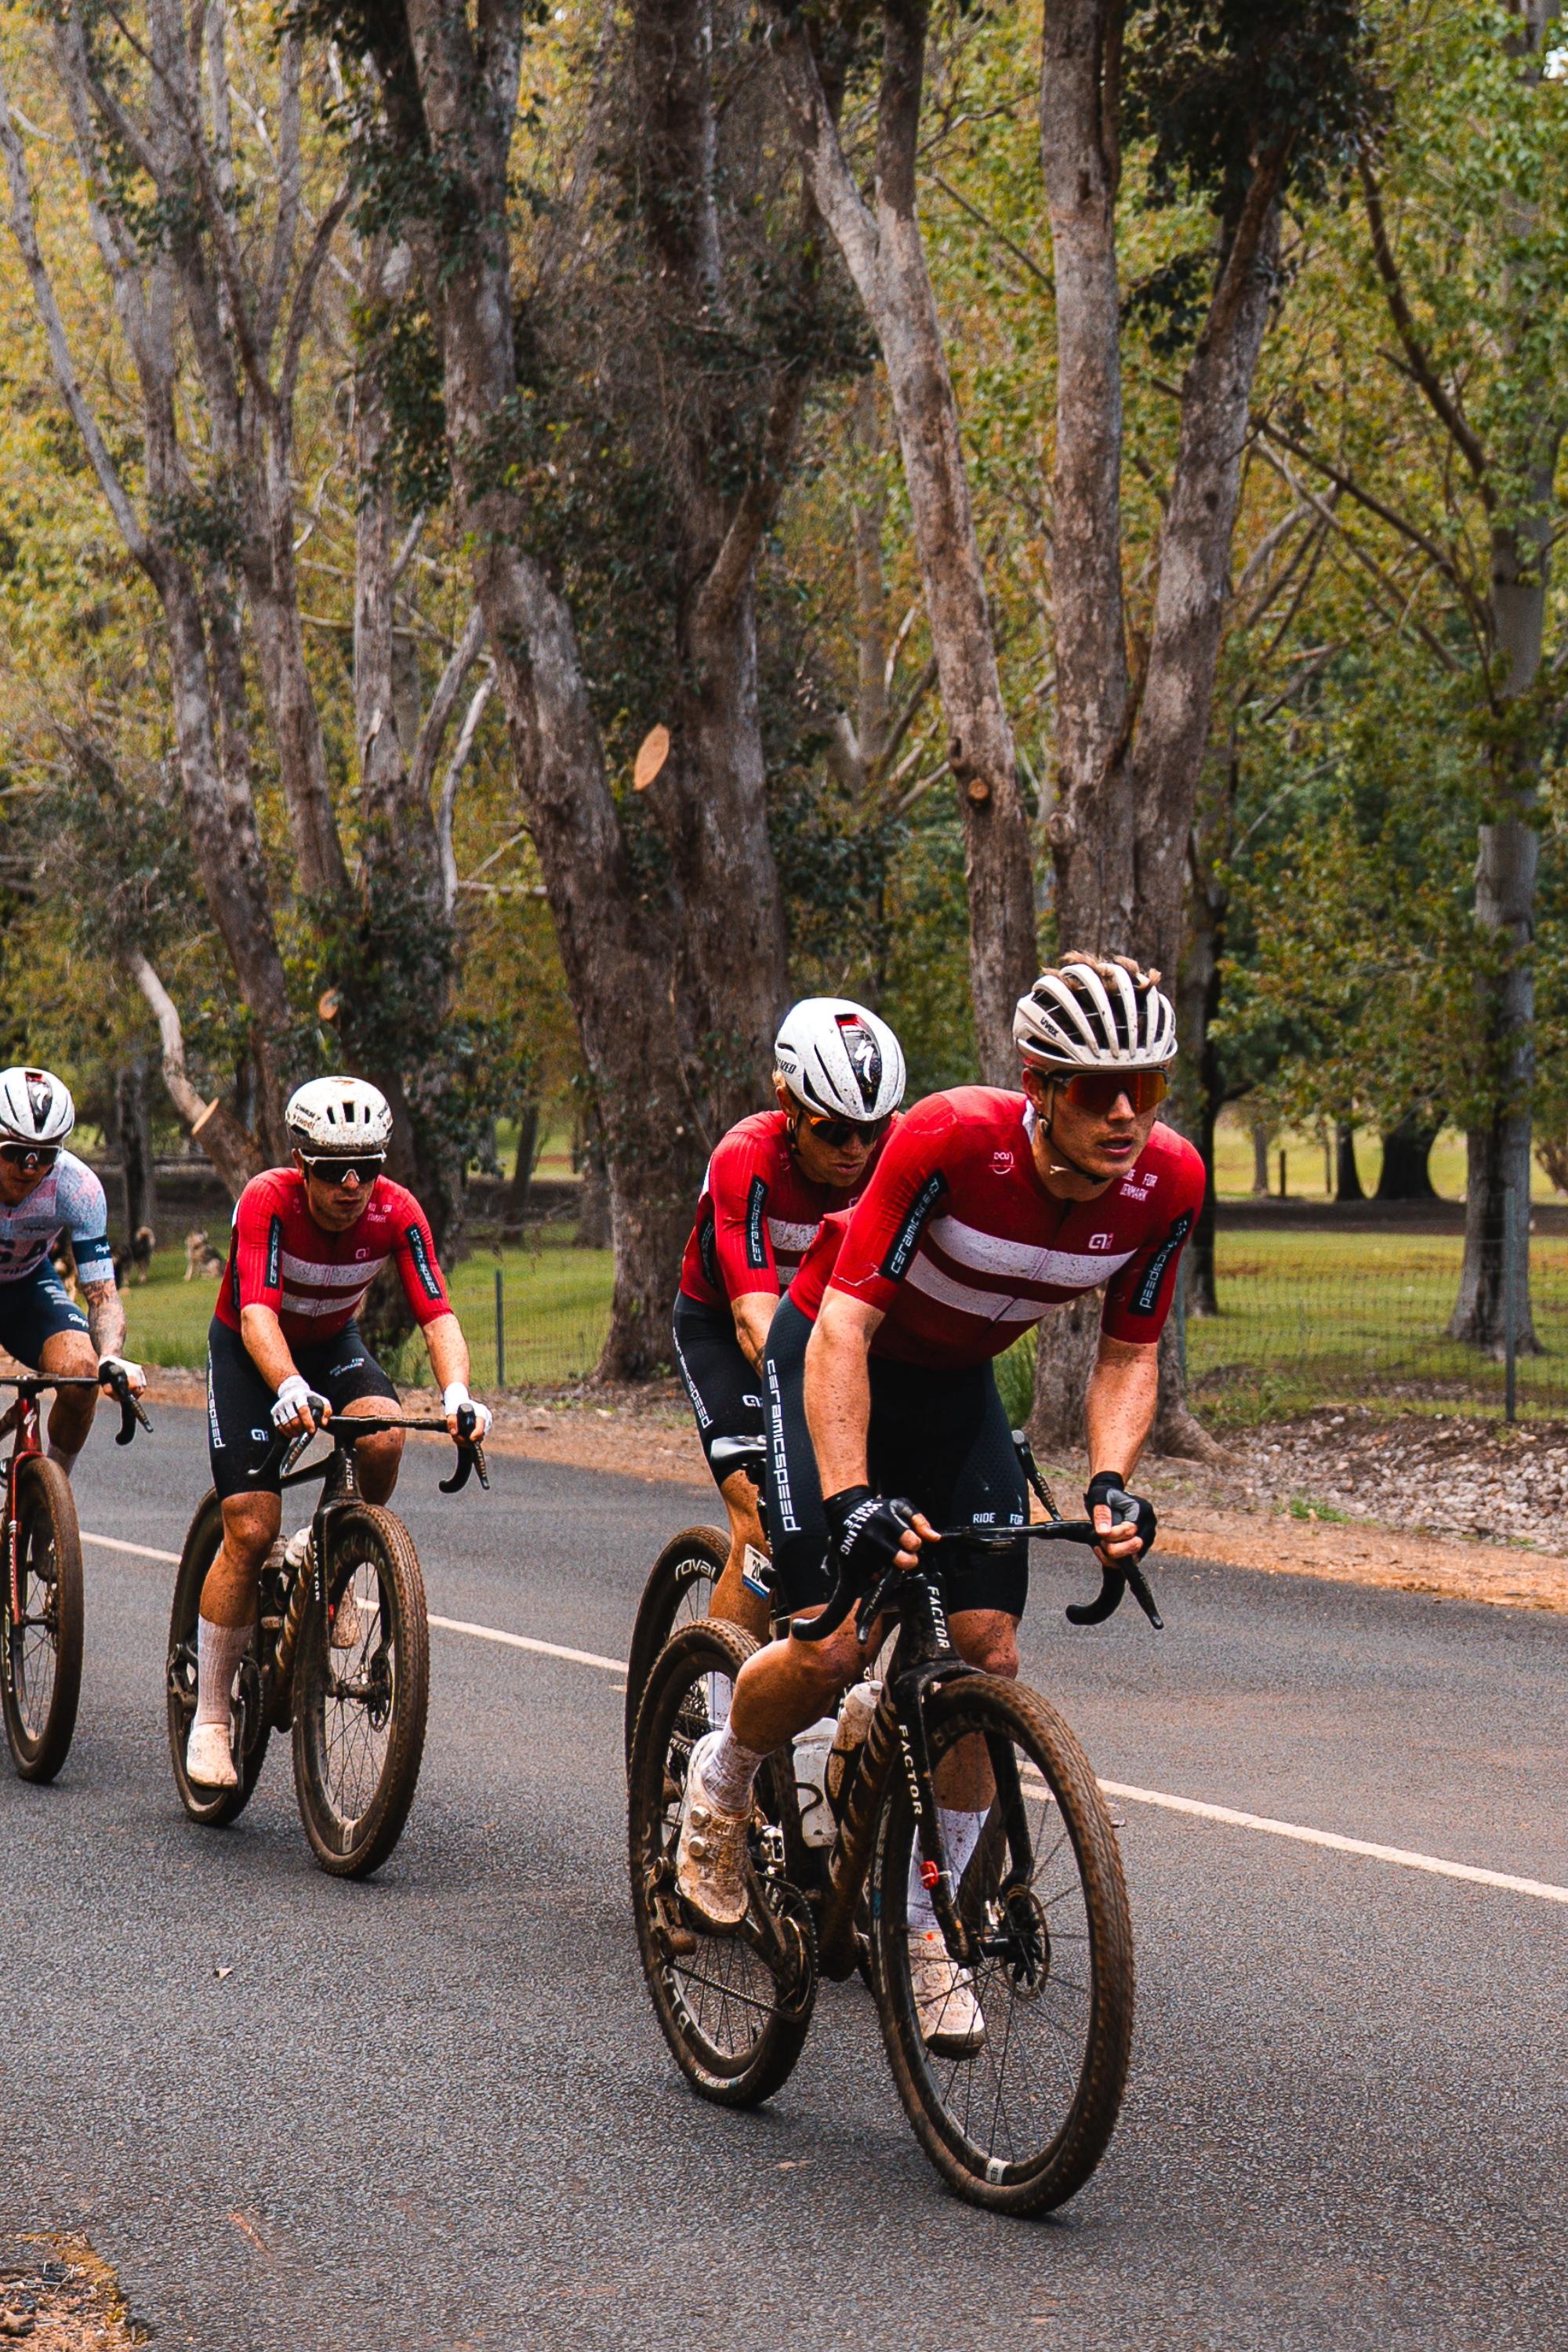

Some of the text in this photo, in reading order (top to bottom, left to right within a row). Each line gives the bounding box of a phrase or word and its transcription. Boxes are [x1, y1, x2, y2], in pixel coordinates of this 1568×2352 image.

[1040, 1017, 1059, 1037] uvex
[1142, 1173, 1159, 1187] FOR
[890, 1178, 940, 1274] ceramicsped
[766, 1359, 802, 1532] ceramicspeed
[840, 1502, 884, 1555] WILLING
[972, 1512, 1024, 1526] RIDE FOR
[675, 1558, 717, 1581] roval
[927, 1585, 951, 1650] FACTOR
[898, 1724, 923, 1816] FACTOR
